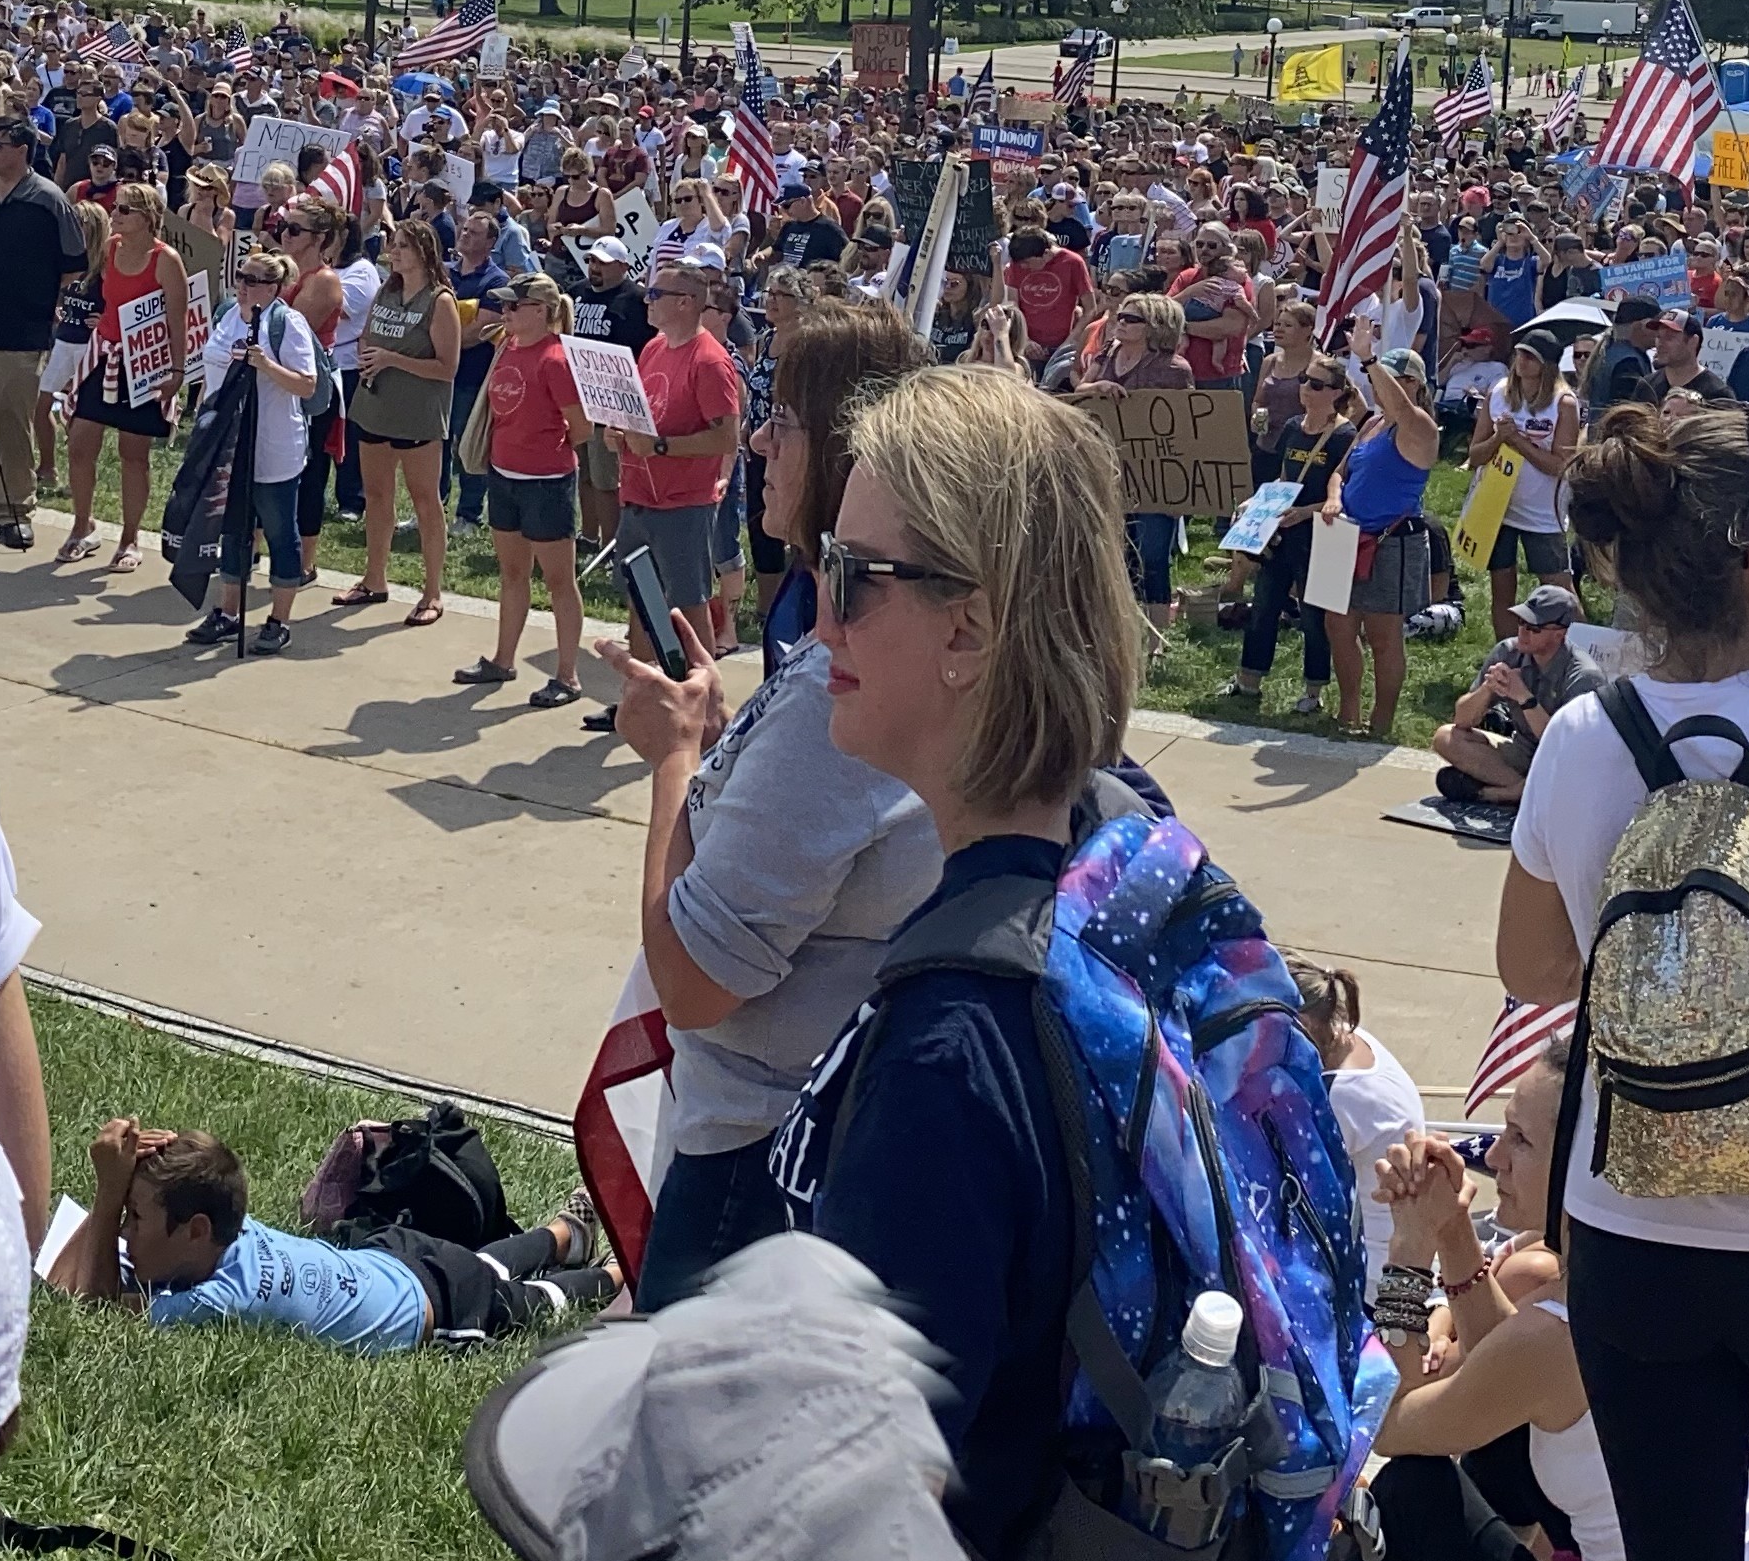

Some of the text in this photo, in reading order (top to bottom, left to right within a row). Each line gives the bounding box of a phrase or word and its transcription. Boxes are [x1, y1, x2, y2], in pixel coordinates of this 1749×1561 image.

[867, 46, 885, 60] MY
[854, 56, 898, 73] CHOICE
[953, 255, 990, 270] KNOW
[1657, 256, 1681, 269] FOR
[580, 348, 633, 378] STAND
[580, 383, 647, 418] FREEDOM
[257, 1265, 276, 1303] 2021
